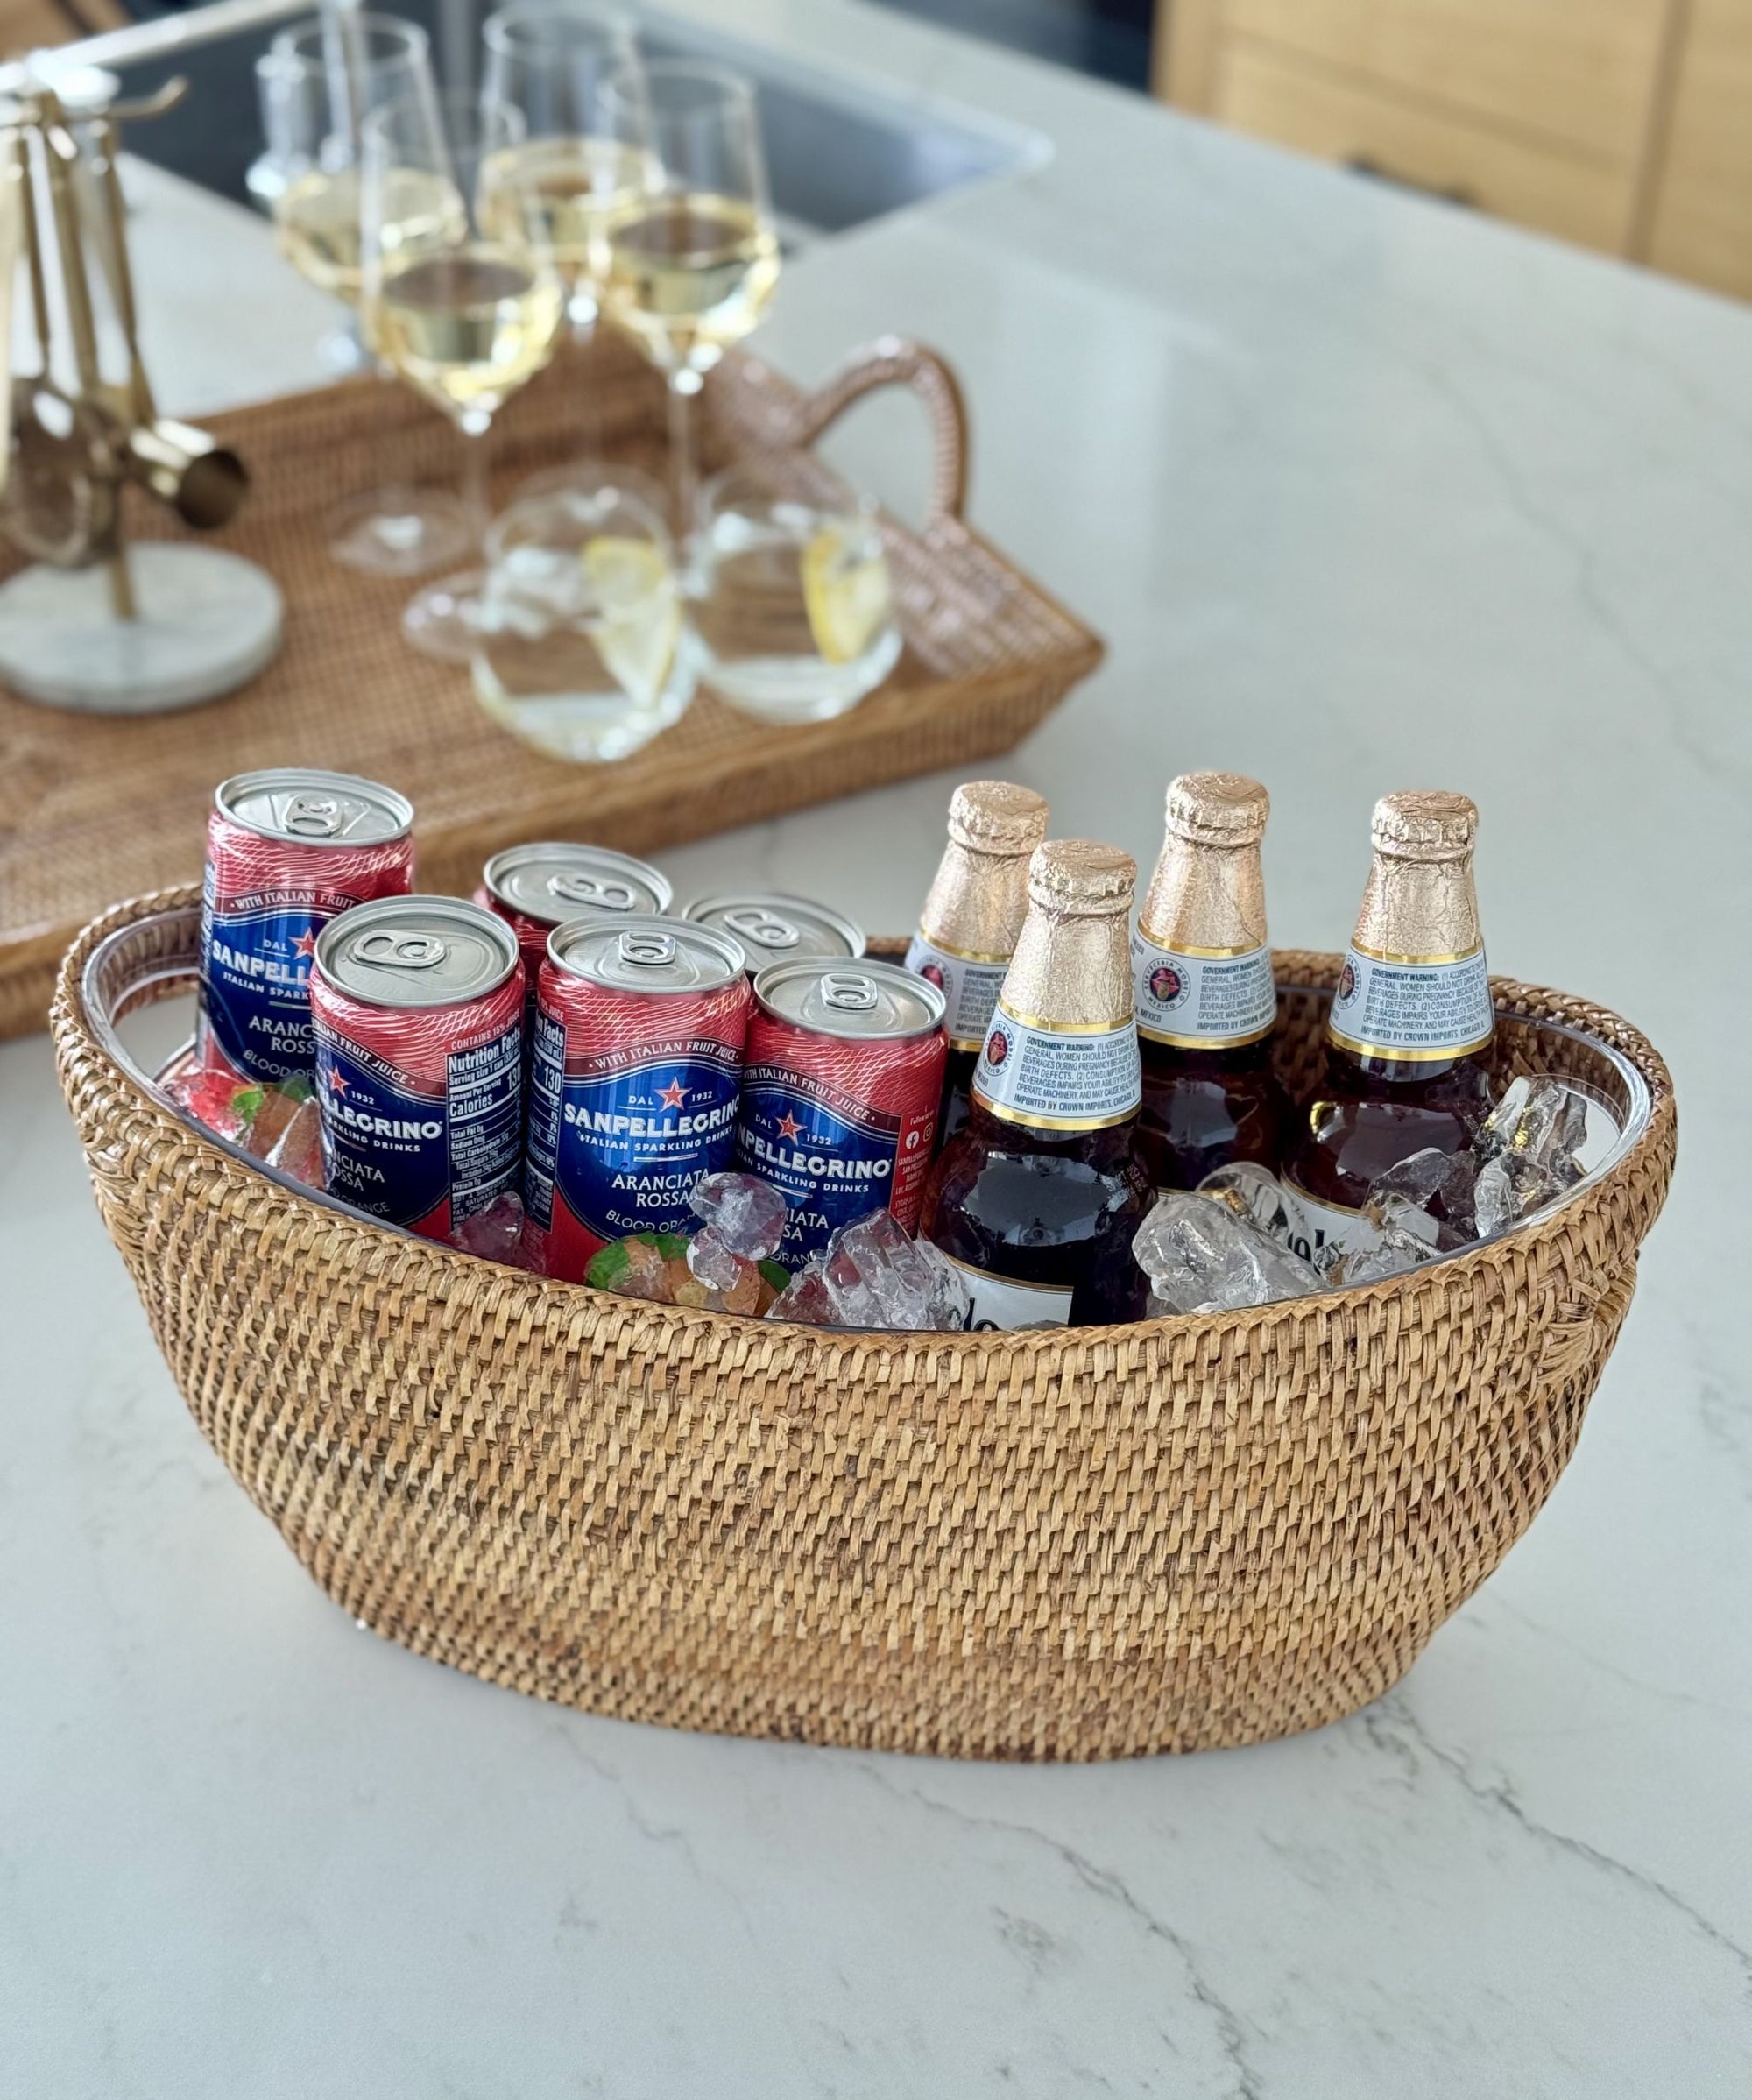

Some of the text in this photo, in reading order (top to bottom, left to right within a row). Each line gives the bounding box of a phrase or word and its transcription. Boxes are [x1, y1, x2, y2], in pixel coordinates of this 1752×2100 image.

[235, 891, 356, 909] WITH ITALIAN FRUIT
[264, 939, 287, 951] DAL
[213, 939, 311, 986] SANPELL
[1203, 965, 1240, 974] GOVERNMENT
[1371, 967, 1409, 980] GOVERNMENT
[1409, 973, 1438, 982] WARNING:
[223, 972, 309, 1000] ITALIAN SPARK
[1368, 986, 1399, 1000] BEVERAGES
[1400, 992, 1422, 1001] DURING
[1423, 991, 1455, 1001] PREGNANCY
[1400, 981, 1424, 992] WOMEN
[1426, 981, 1452, 991] SHOULD
[1452, 978, 1462, 988] NOT
[1199, 1001, 1235, 1010] BEVERAGES
[1367, 995, 1384, 1007] BIRTH
[1140, 1008, 1162, 1023] MEXICO
[1365, 1005, 1400, 1019] BEVERAGES
[1402, 1010, 1428, 1020] IMPAIRS
[1429, 1010, 1447, 1020] YOUR
[249, 1015, 312, 1037] ARANC
[543, 1018, 564, 1048] Facts
[1361, 1026, 1391, 1039] IMPORTED
[1393, 1031, 1402, 1040] BY
[1404, 1032, 1430, 1041] CROWN
[1424, 1021, 1437, 1029] AND
[271, 1037, 315, 1054] ROSS
[451, 1029, 491, 1050] CONTAINS
[1027, 1036, 1065, 1050] GOVERNMENT
[449, 1044, 499, 1073] Nutrition
[502, 1027, 520, 1053] Facts
[595, 1038, 736, 1070] WITH ITALIAN FRUIT JUICE
[1056, 1052, 1080, 1061] WOMEN
[1082, 1051, 1106, 1061] SHOULD
[341, 1037, 409, 1084] FRUIT JUICE
[1023, 1054, 1055, 1069] BEVERAGES
[1056, 1061, 1077, 1071] DURING
[1078, 1060, 1109, 1071] PREGNANCY
[449, 1072, 475, 1086] Serving
[476, 1067, 489, 1078] size
[507, 1063, 521, 1091] 130
[1021, 1064, 1039, 1076] BIRTH
[545, 1065, 562, 1094] 130
[1019, 1073, 1056, 1086] BEVERAGES
[1057, 1080, 1083, 1090] IMPAIRS
[1084, 1080, 1101, 1089] YOUR
[351, 1091, 375, 1105] 1932
[449, 1090, 472, 1102] Amount
[628, 1091, 713, 1105] DAL 1932
[759, 1068, 870, 1121] ITALIAN FRUIT JUICE
[1016, 1083, 1042, 1096] OPERATE
[1079, 1090, 1091, 1099] AND
[1092, 1089, 1104, 1099] MAY
[449, 1094, 492, 1117] Calories
[1014, 1093, 1046, 1108] IMPORTED
[1048, 1101, 1056, 1110] BY
[1059, 1102, 1084, 1111] CROWN
[564, 1094, 739, 1138] SANPELLEGRINO
[580, 1124, 732, 1153] ITALIAN SPARKLING DRINKS
[755, 1114, 832, 1146] DAL 1932
[373, 1140, 420, 1152] DRINKS
[738, 1123, 891, 1179] NPELLEGRINO
[333, 1150, 385, 1183] NCIATA
[611, 1168, 710, 1191] ARANCIATA
[757, 1163, 869, 1193] SPARKLING DRINKS
[636, 1191, 693, 1207] ROSSA
